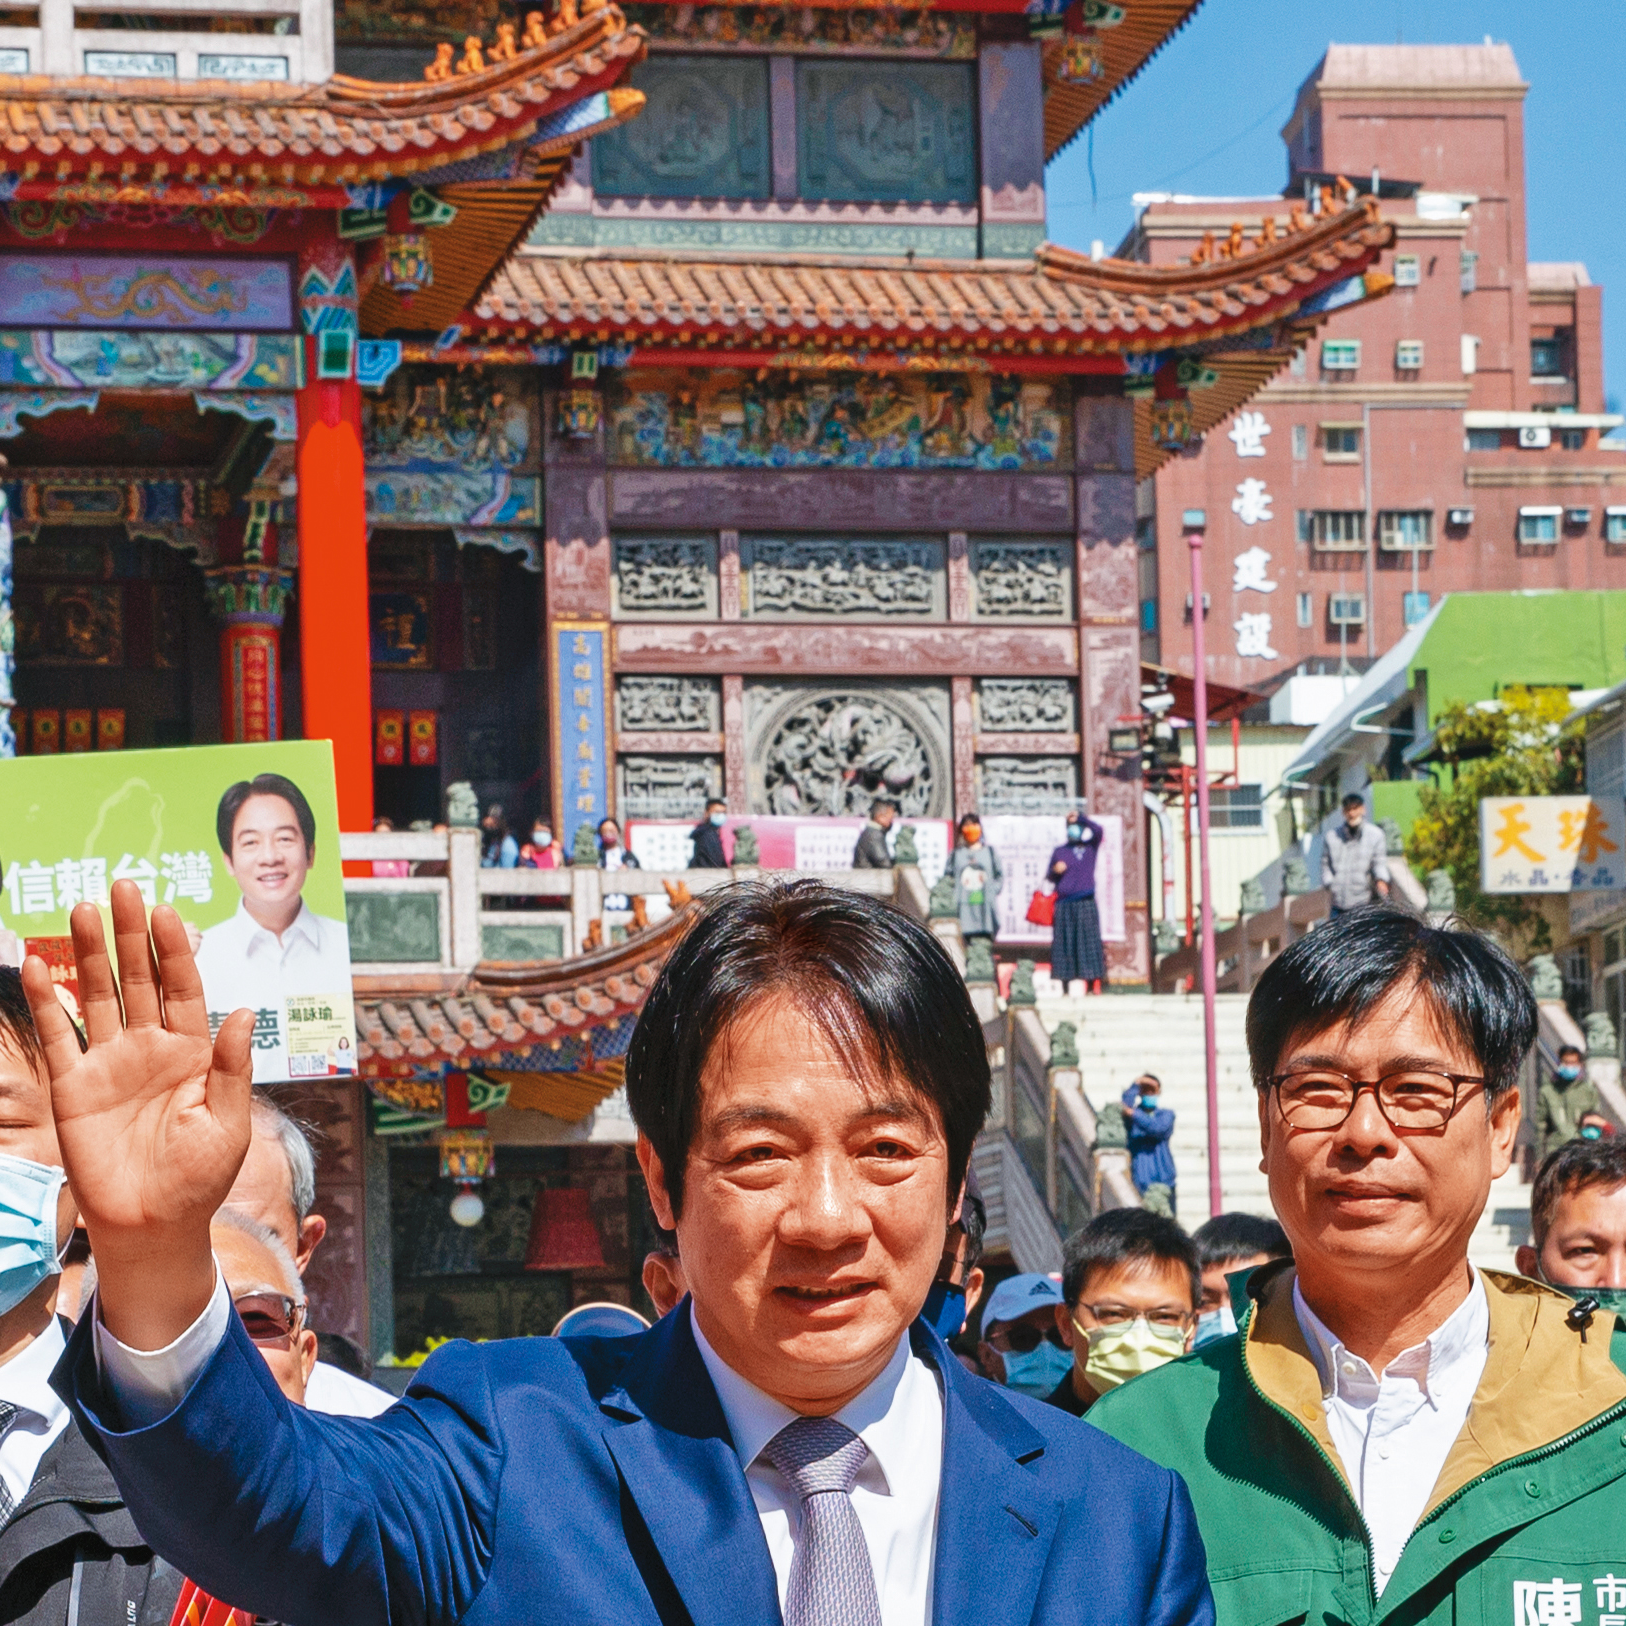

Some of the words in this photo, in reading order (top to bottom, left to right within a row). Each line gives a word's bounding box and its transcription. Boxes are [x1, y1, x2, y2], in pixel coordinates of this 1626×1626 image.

[1228, 411, 1278, 660] 世豪建設
[1493, 802, 1619, 864] 天珠
[3, 850, 213, 916] 信賴台灣
